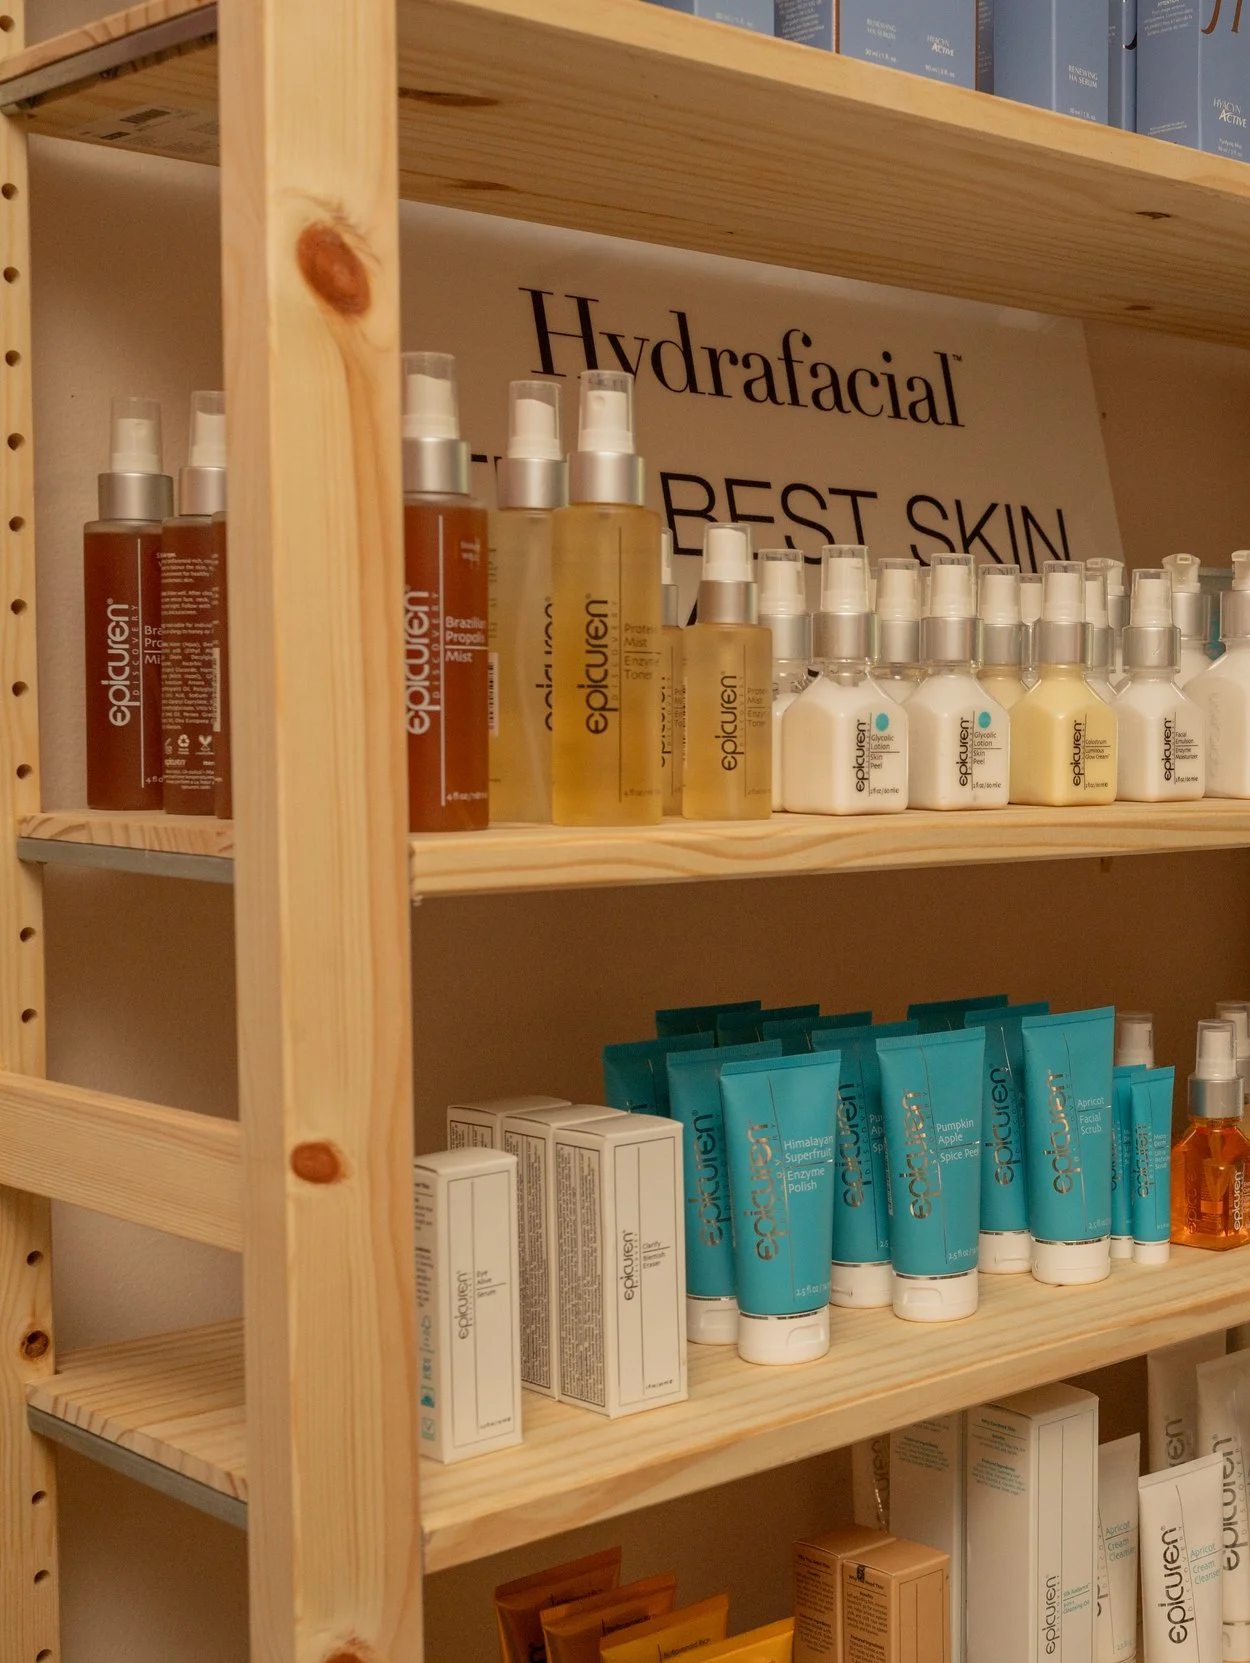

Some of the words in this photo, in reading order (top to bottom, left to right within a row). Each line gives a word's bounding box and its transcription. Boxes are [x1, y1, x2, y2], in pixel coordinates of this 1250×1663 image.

[931, 42, 955, 57] ACTIVE
[1068, 64, 1098, 81] RENEWING
[1079, 76, 1098, 89] SERUM
[1219, 109, 1247, 128] ACTIVE
[660, 472, 877, 565] BEST
[906, 494, 1073, 573] SKIN
[100, 600, 141, 727] epicuren
[404, 590, 441, 735] epicuren
[446, 650, 473, 662] Mist
[577, 599, 618, 735] epicuren
[714, 675, 744, 772] epicuren
[871, 734, 895, 743] Glycolic
[974, 731, 997, 739] Glycolic
[974, 739, 993, 747] Lotion
[852, 721, 870, 793] epicuren
[956, 719, 972, 787] epicuren
[1070, 720, 1085, 787] epicuren
[1161, 719, 1175, 782] epicuren
[1077, 1096, 1105, 1109] Apricot
[936, 1118, 975, 1133] Pumpkin
[985, 1067, 1020, 1186] epicuren
[1079, 1112, 1101, 1124] Facial
[1043, 1072, 1081, 1195] epicuren
[1080, 1123, 1102, 1135] Scrub
[784, 1134, 834, 1151] Himalayan
[838, 1083, 872, 1208] epicuren
[938, 1133, 963, 1145] Apple
[785, 1147, 832, 1164] Superfruit
[899, 1090, 942, 1220] epicuren
[940, 1149, 963, 1163] Spice
[964, 1147, 980, 1158] Peel
[688, 1113, 732, 1247] epicuren
[787, 1166, 826, 1181] Enzyme
[743, 1123, 789, 1262] epicuren
[788, 1180, 818, 1194] Polish
[1231, 1171, 1243, 1231] epicuren
[642, 1240, 661, 1250] Clarify
[642, 1251, 666, 1262] Blemish
[620, 1231, 638, 1301] epicuren
[453, 1272, 473, 1340] epicuren
[1105, 1521, 1130, 1535] Apricot
[1108, 1538, 1129, 1551] Cream
[1190, 1543, 1216, 1558] Apricot
[1192, 1560, 1216, 1574] Cream
[1158, 1527, 1194, 1644] epicuren
[1194, 1569, 1222, 1585] Cleanser
[1042, 1576, 1060, 1654] epicuren
